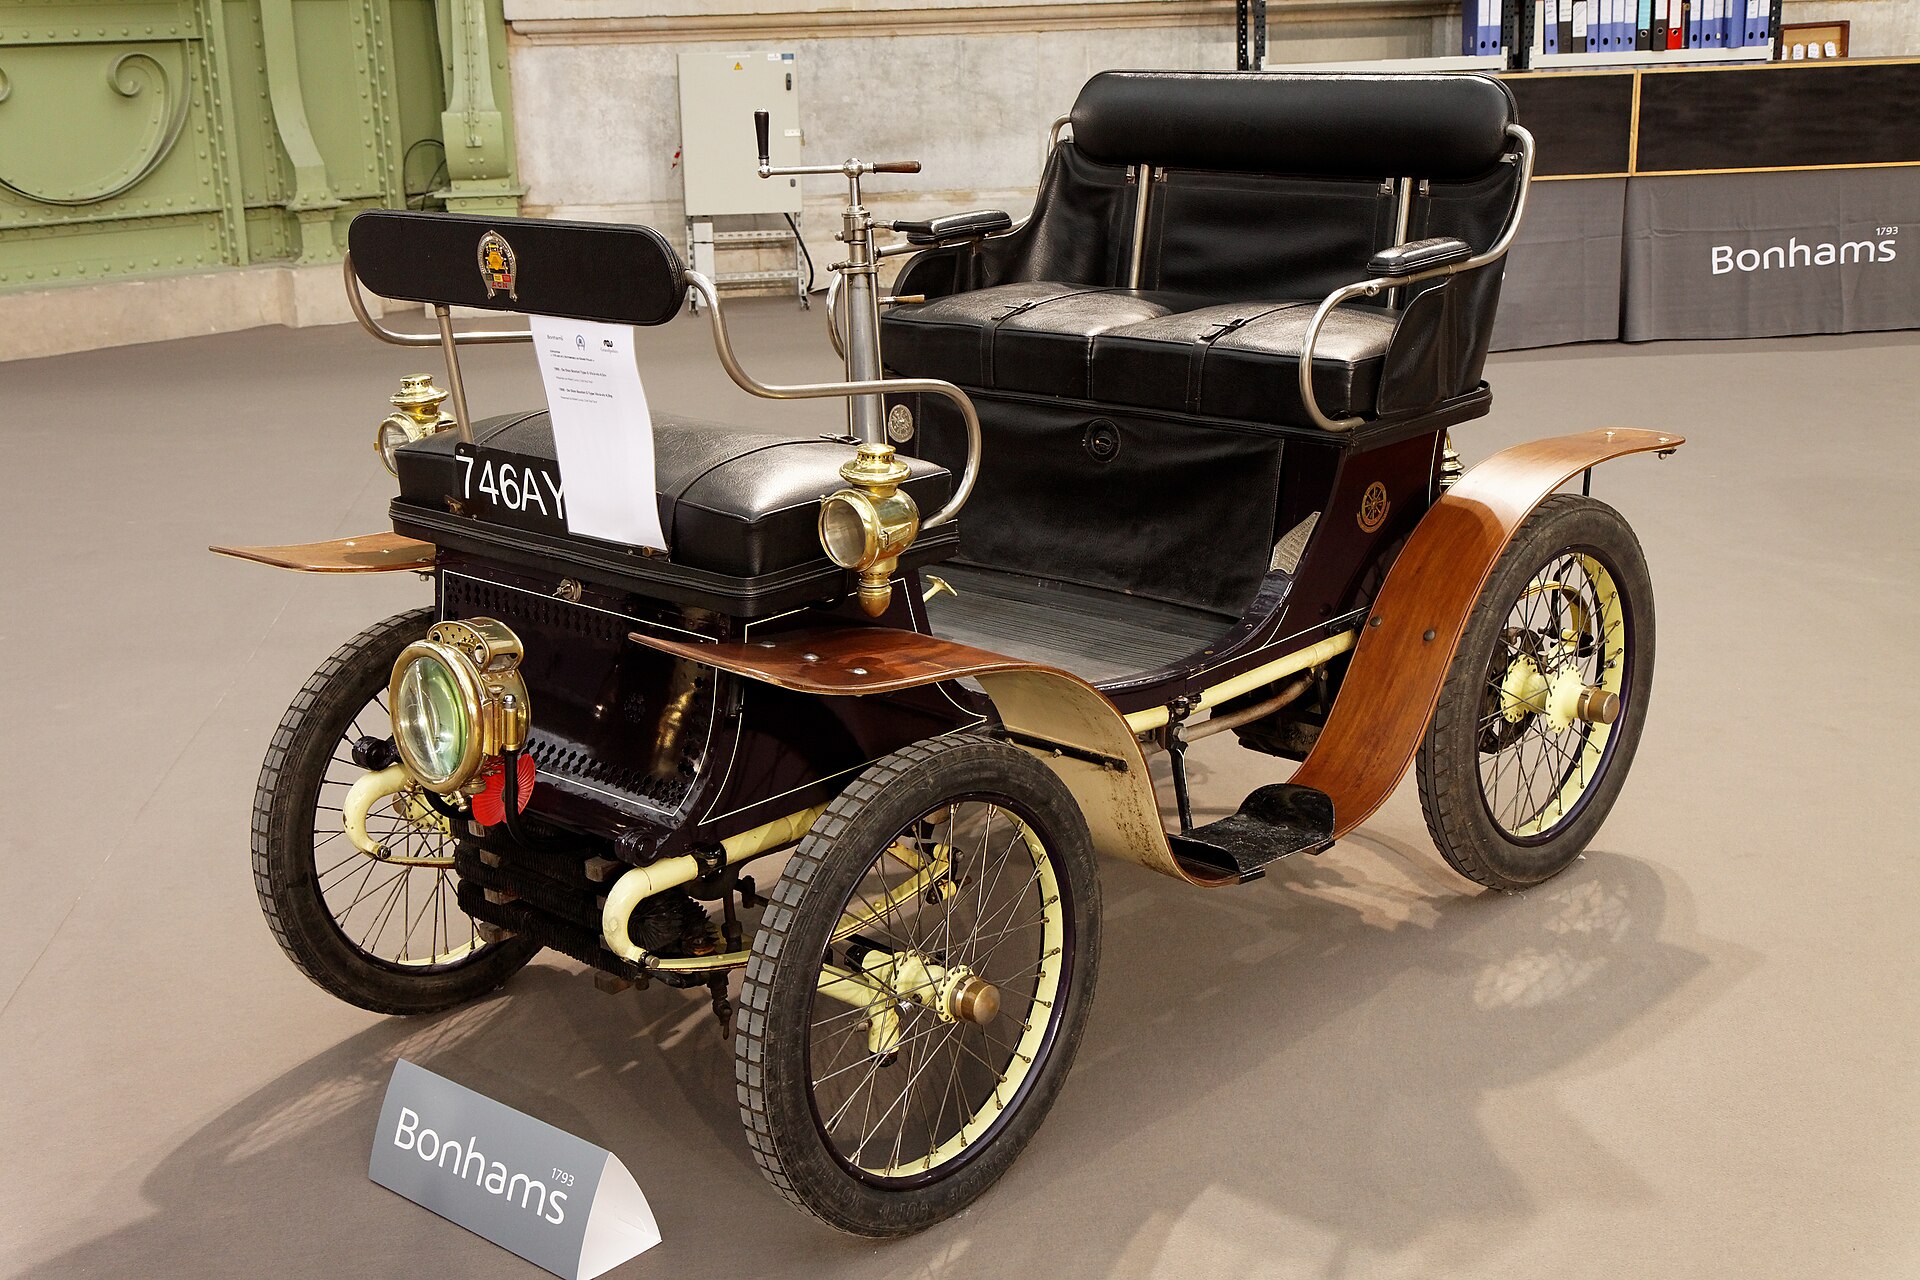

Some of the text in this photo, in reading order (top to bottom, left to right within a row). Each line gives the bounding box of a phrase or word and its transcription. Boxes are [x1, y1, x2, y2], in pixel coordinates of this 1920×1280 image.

[1875, 226, 1899, 236] 1793
[1711, 236, 1897, 275] Bonhams
[393, 1106, 568, 1225] Bonhams
[551, 1167, 575, 1187] 1793
